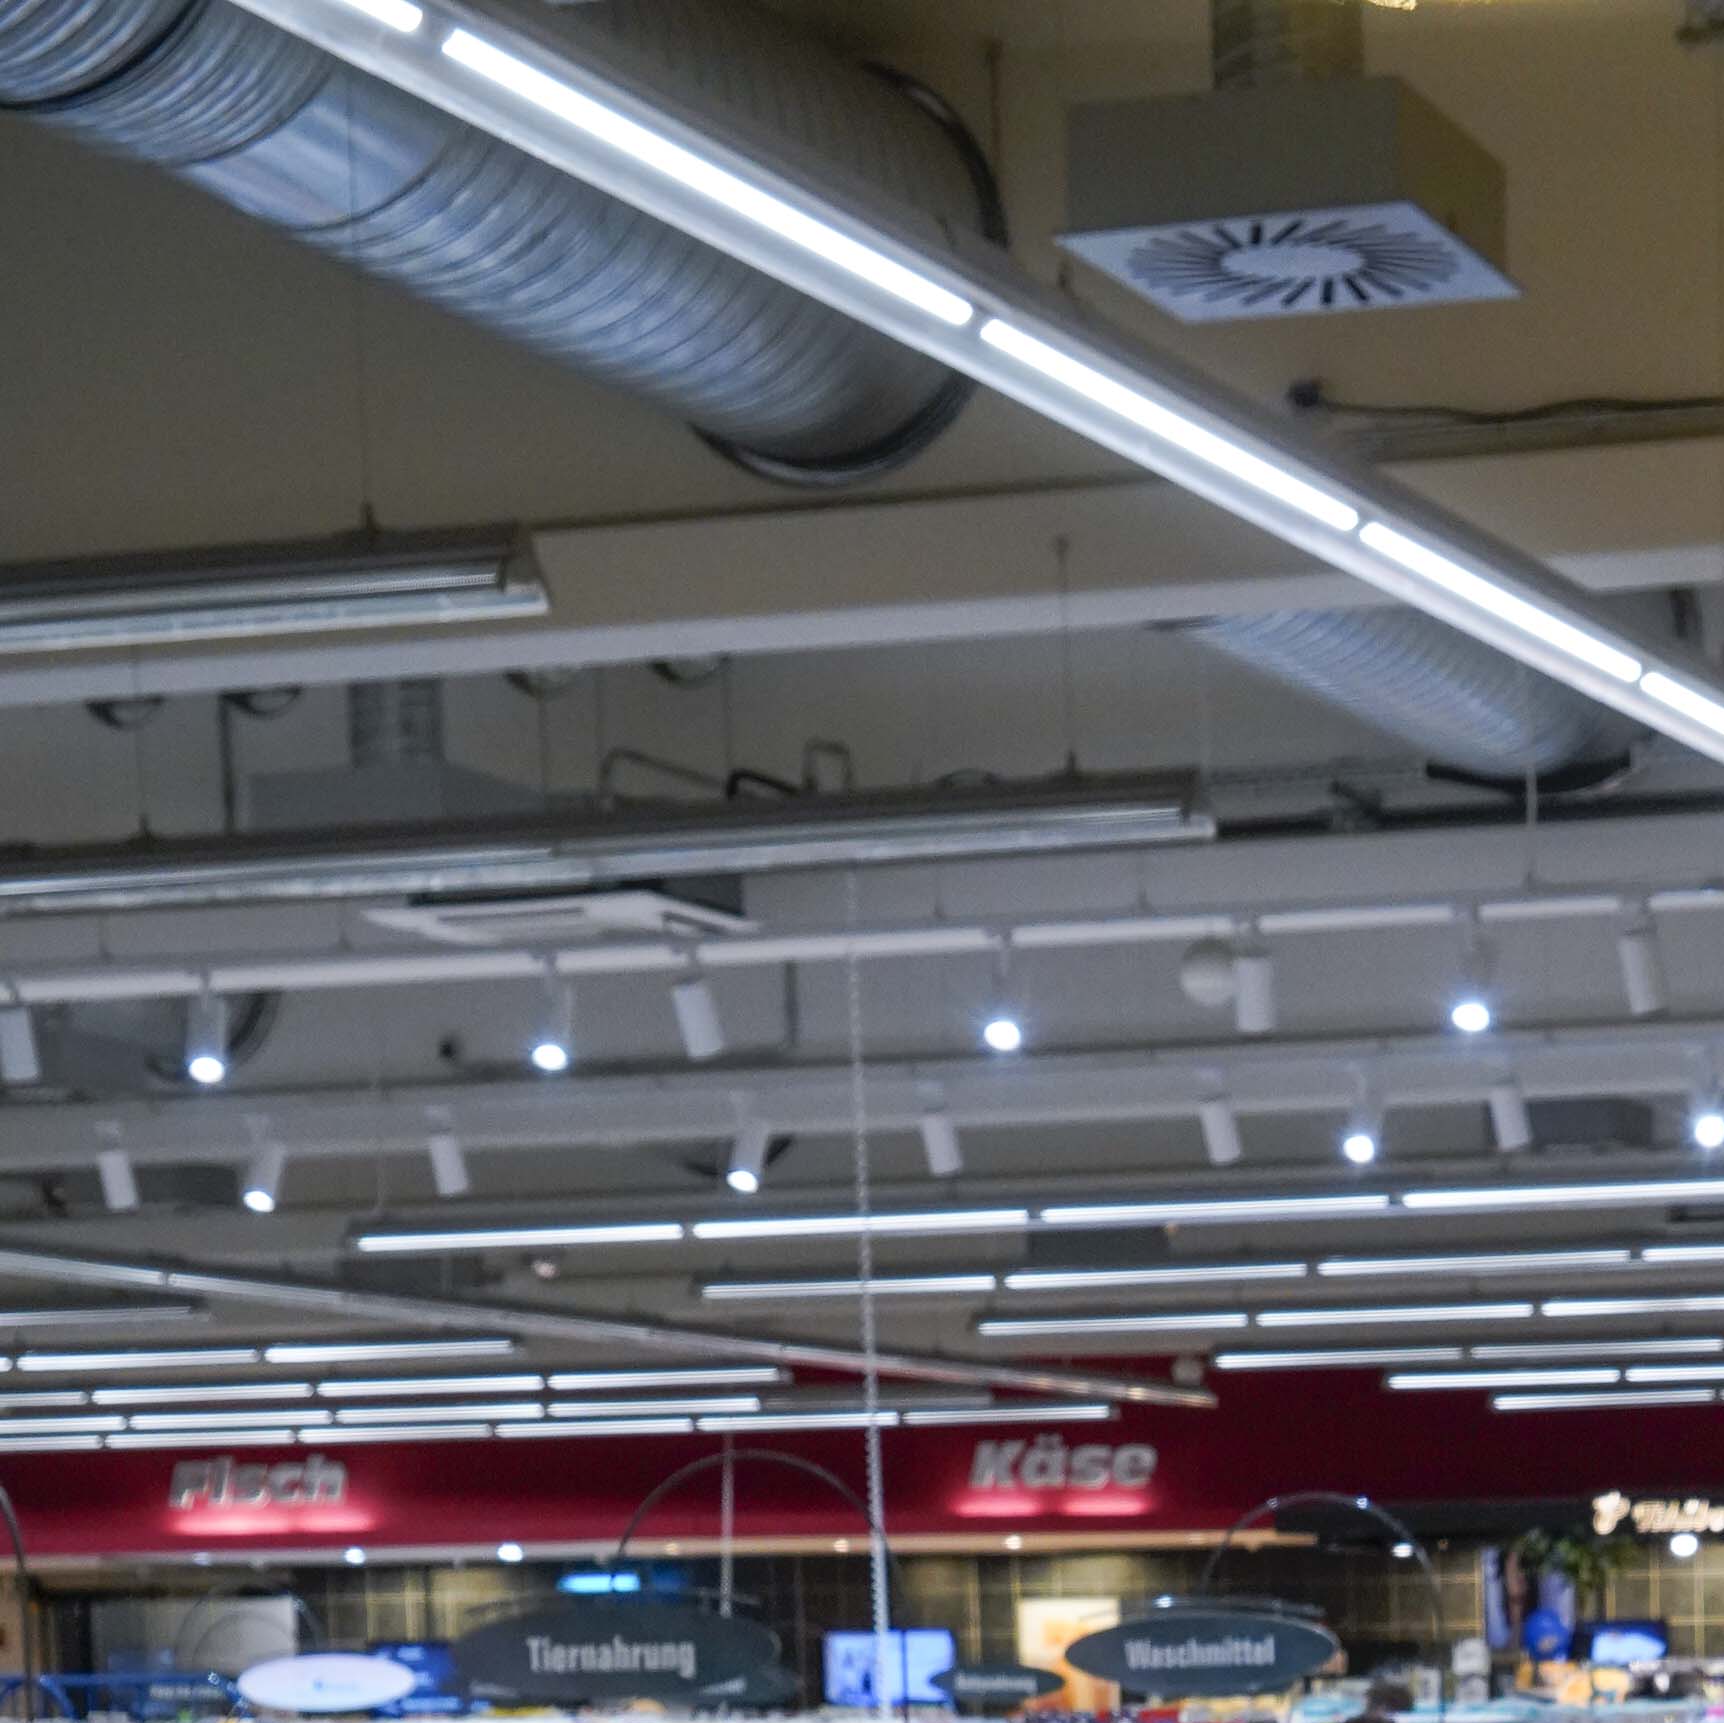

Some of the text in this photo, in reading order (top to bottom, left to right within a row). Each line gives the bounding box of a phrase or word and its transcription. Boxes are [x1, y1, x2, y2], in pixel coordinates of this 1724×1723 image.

[170, 1453, 346, 1509] Fisch
[970, 1433, 1157, 1488] Käse
[526, 1635, 694, 1678] Tiernahrung
[1125, 1635, 1275, 1668] Waschmittel
